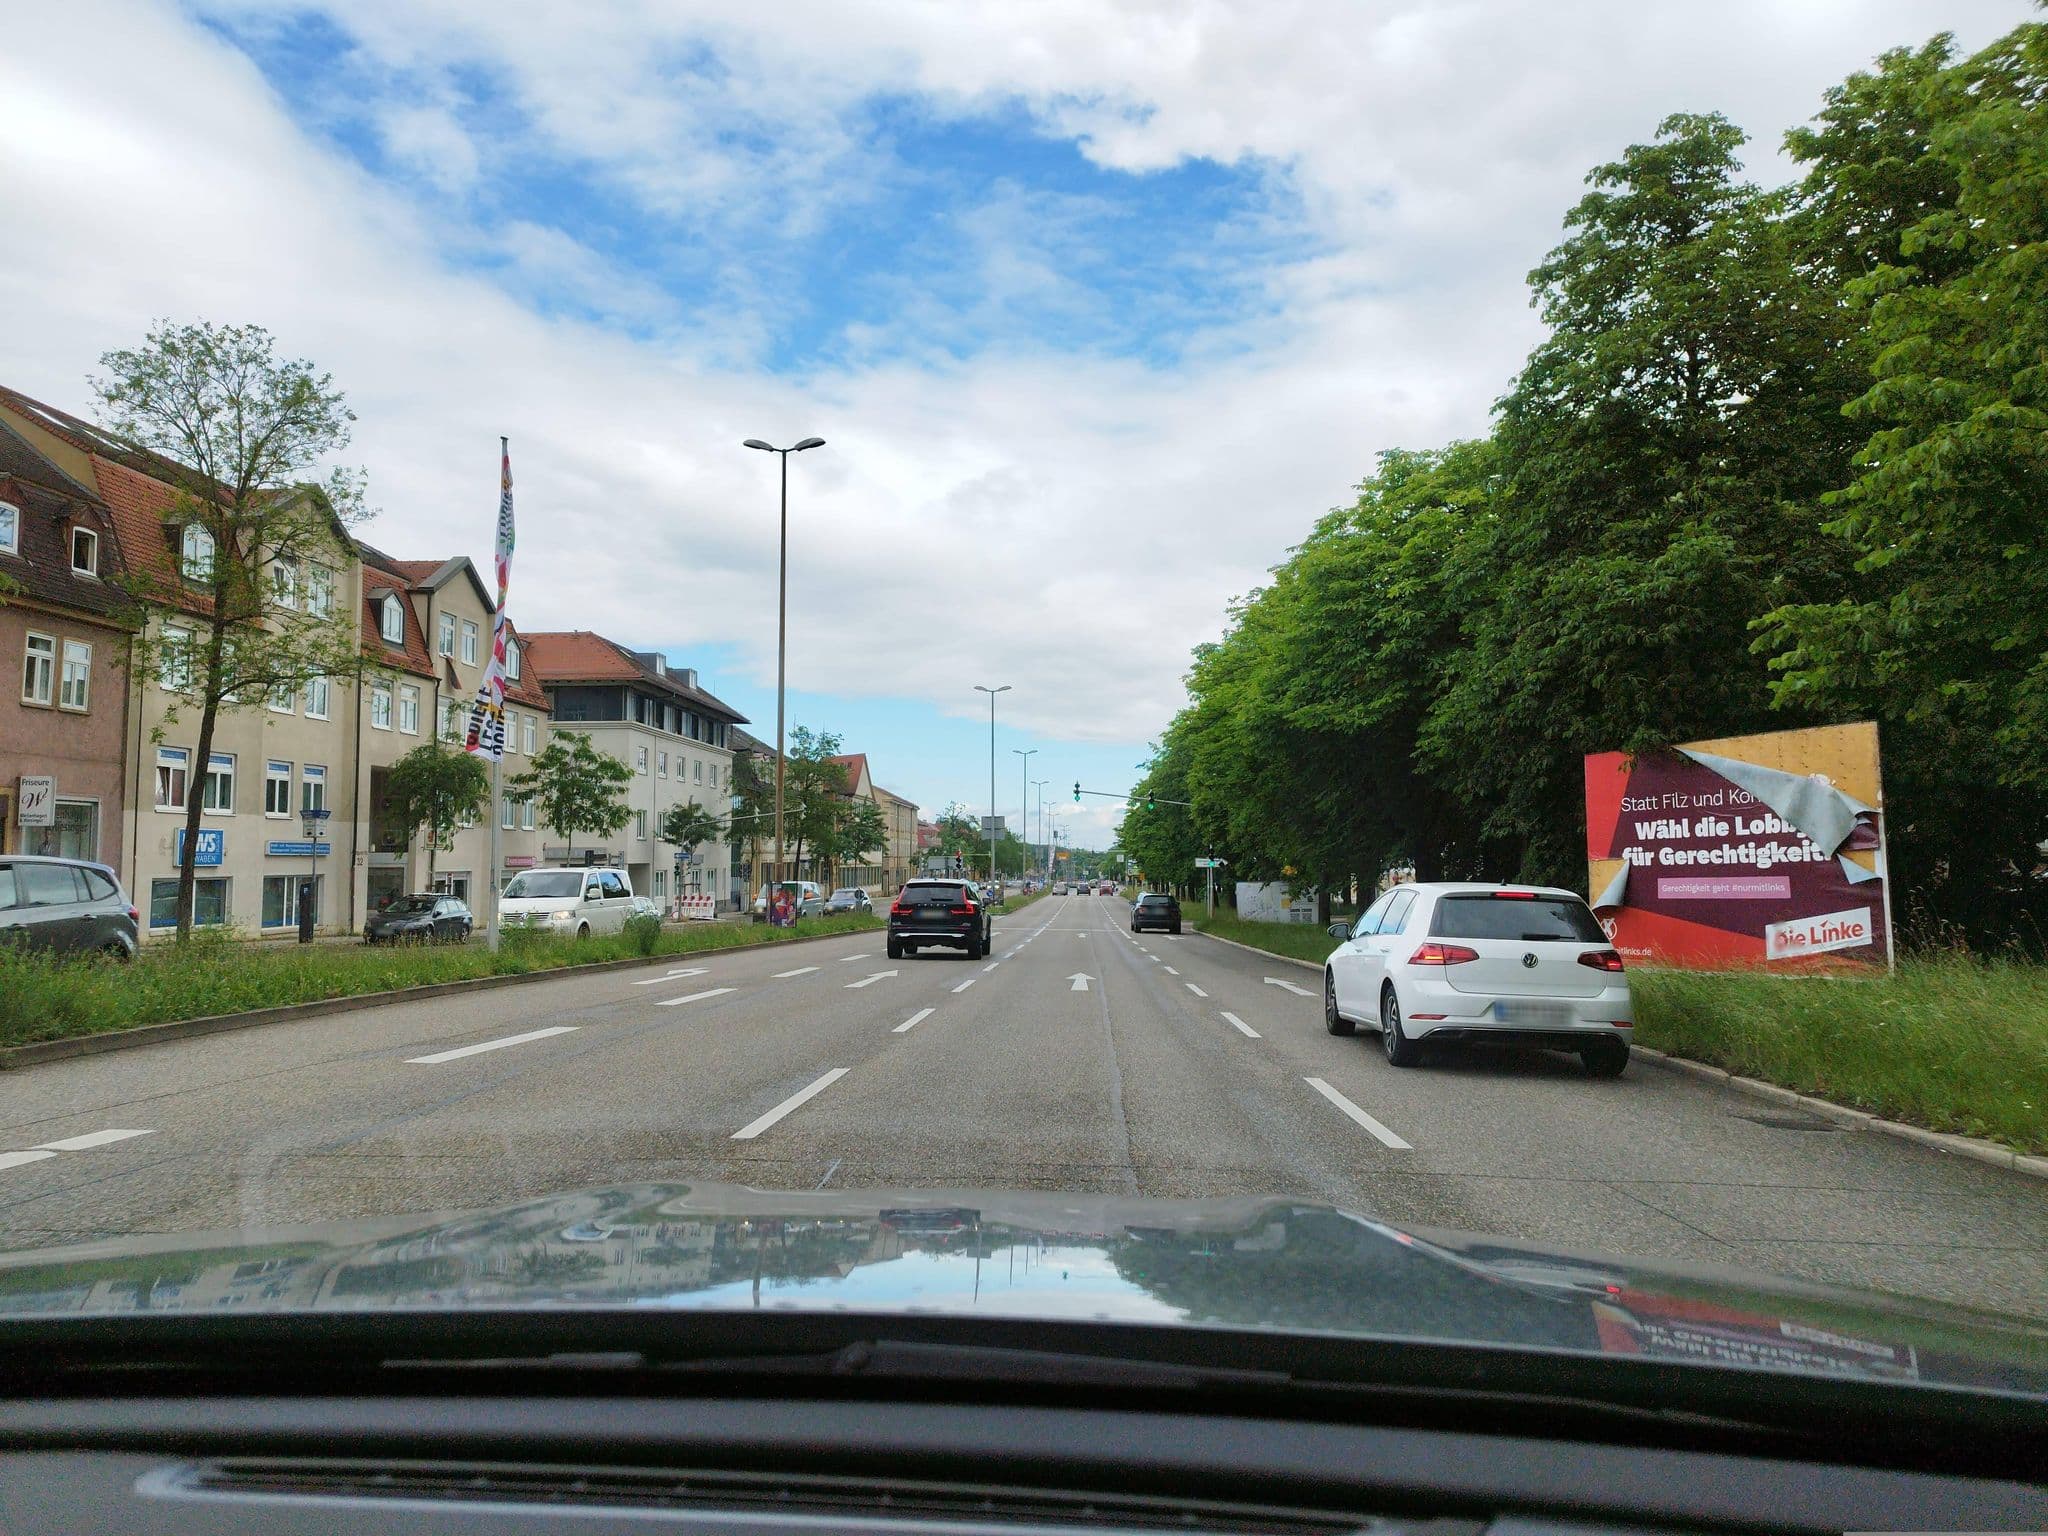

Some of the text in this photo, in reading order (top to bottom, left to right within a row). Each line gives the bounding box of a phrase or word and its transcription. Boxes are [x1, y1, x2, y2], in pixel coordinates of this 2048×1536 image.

[22, 778, 49, 786] Friseure
[1621, 796, 1658, 812] Statt
[1662, 791, 1689, 809] Filz
[1693, 789, 1723, 807] und
[1635, 818, 1691, 840] Wähl
[1694, 816, 1730, 837] die
[1622, 847, 1654, 866] für
[1662, 882, 1785, 894] Gerechtigkeit geht #nurmitlinks
[1810, 920, 1864, 945] Linke
